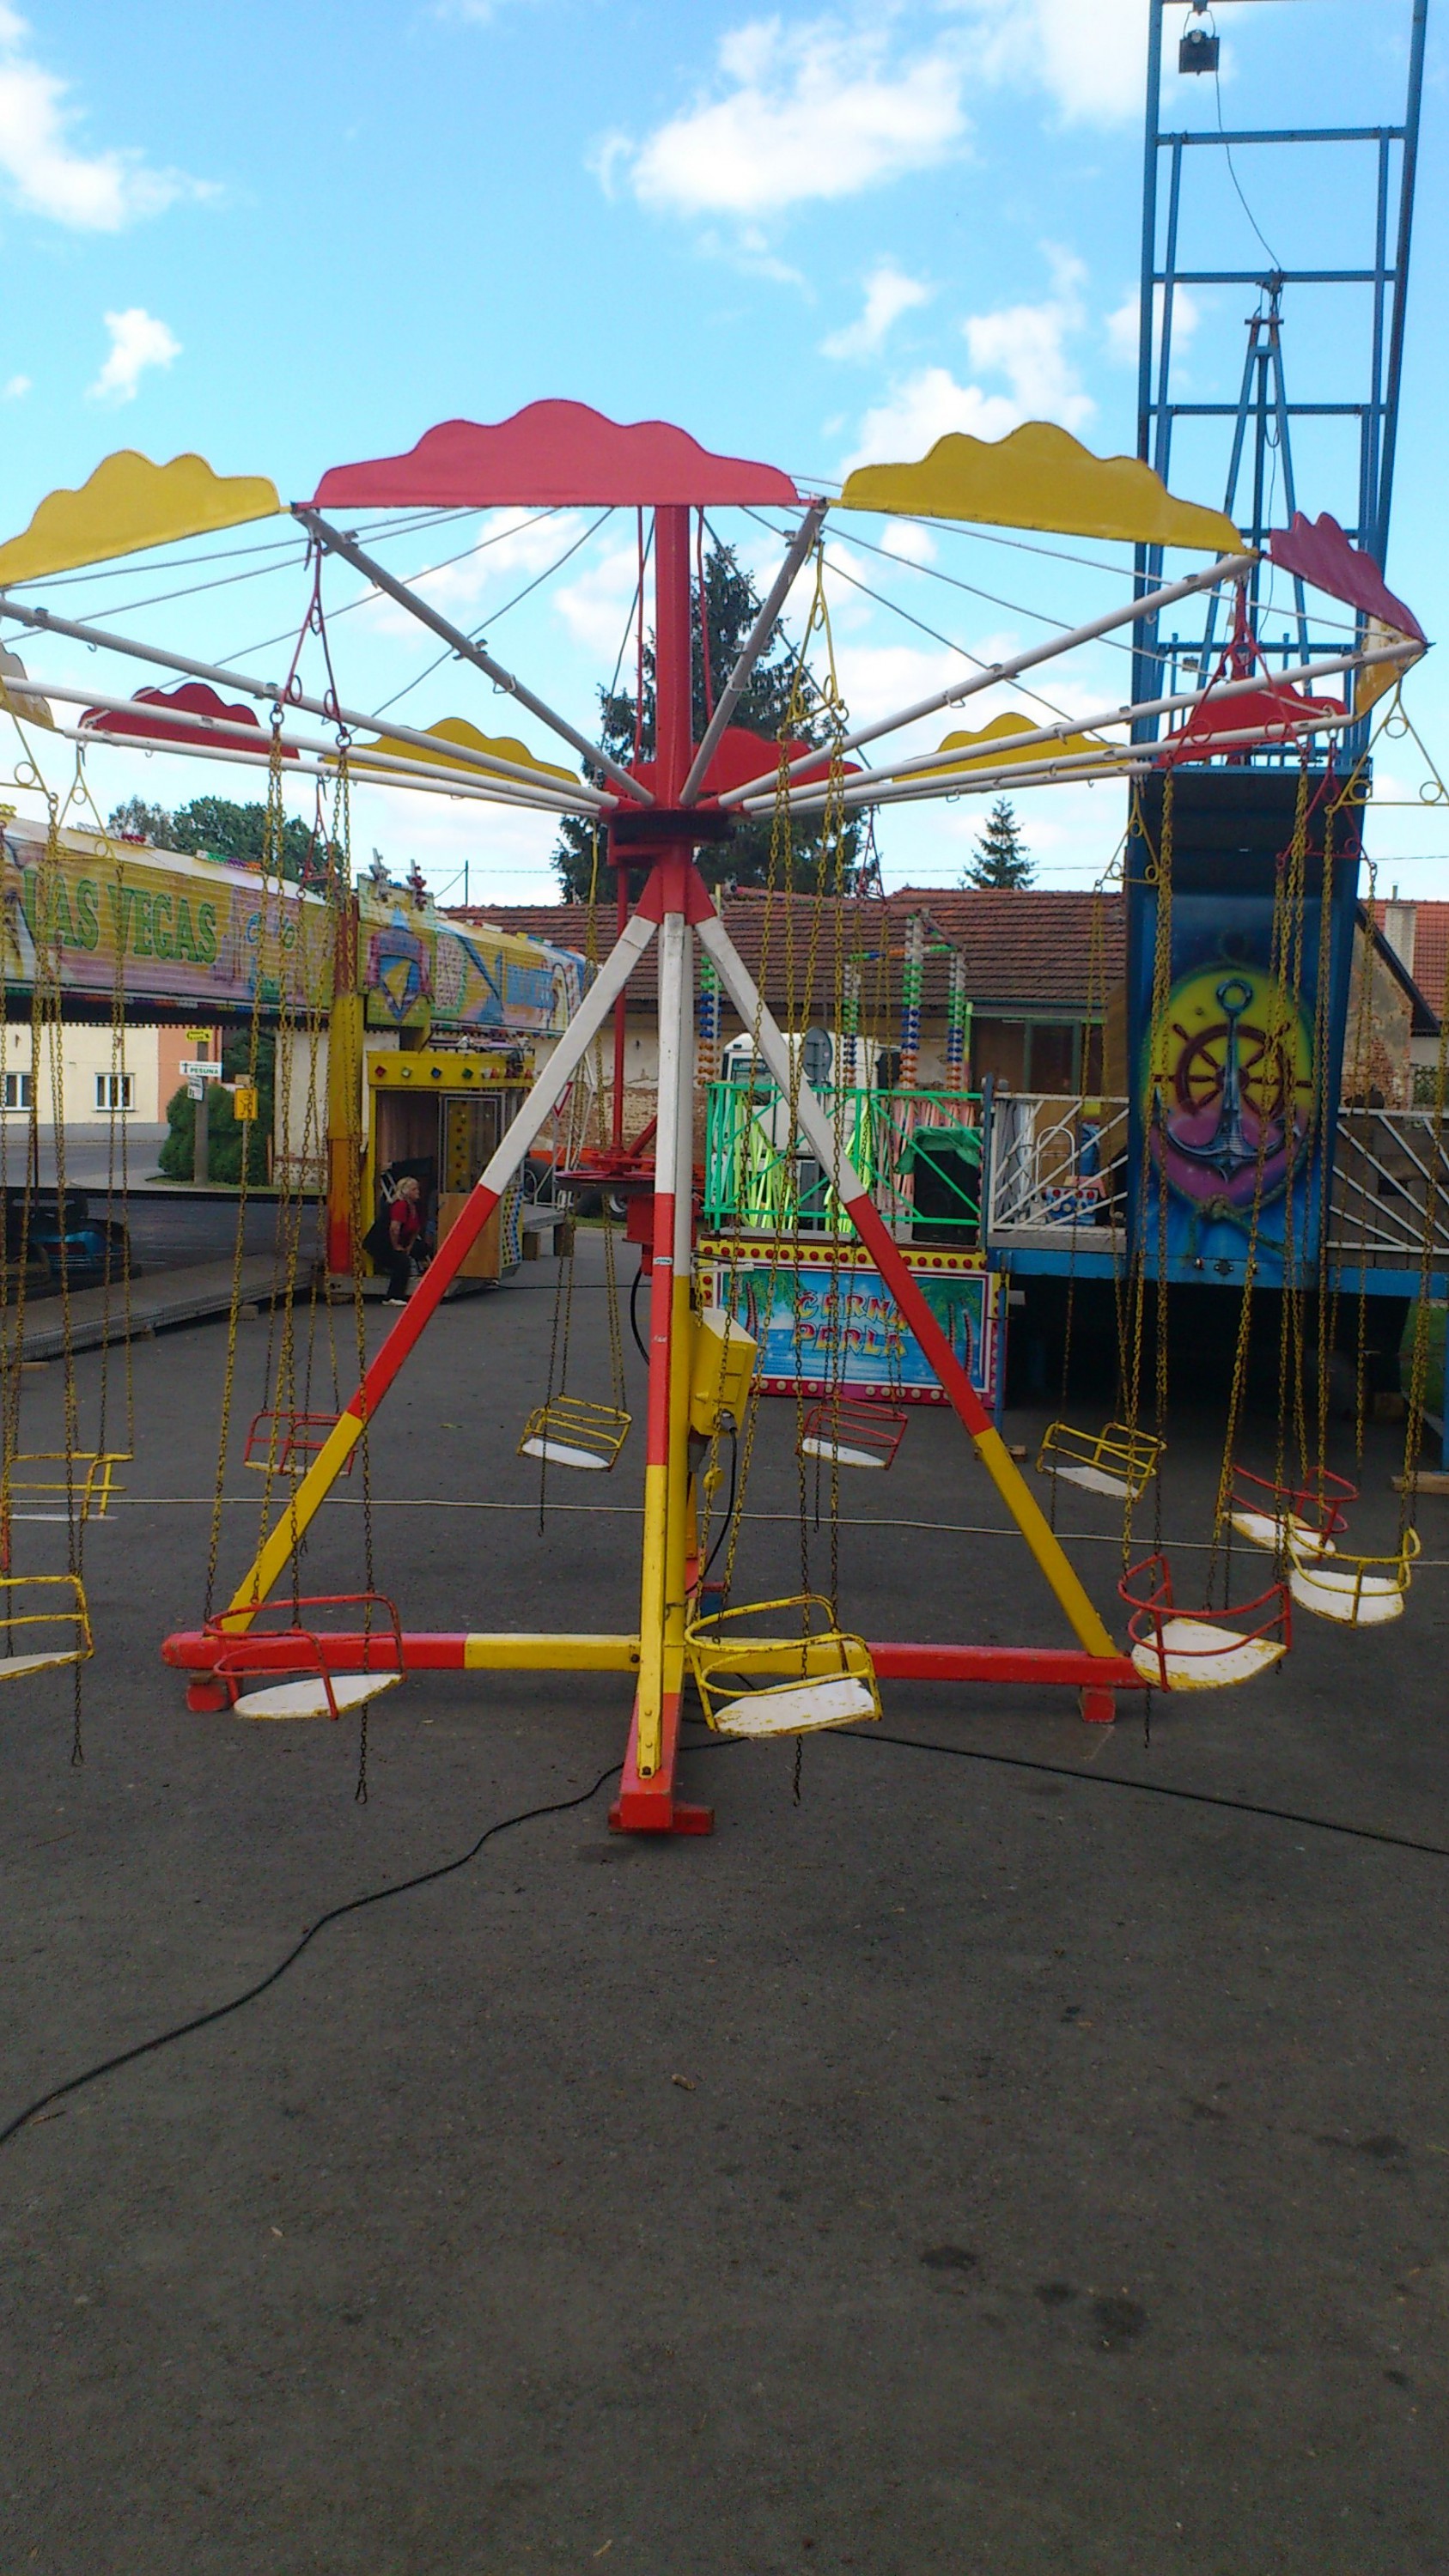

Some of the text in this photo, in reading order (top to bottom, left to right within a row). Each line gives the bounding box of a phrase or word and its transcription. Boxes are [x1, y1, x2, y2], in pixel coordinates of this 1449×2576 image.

[21, 867, 100, 951] LAS
[107, 884, 216, 963] VEGAS
[791, 1321, 907, 1358] PERLA
